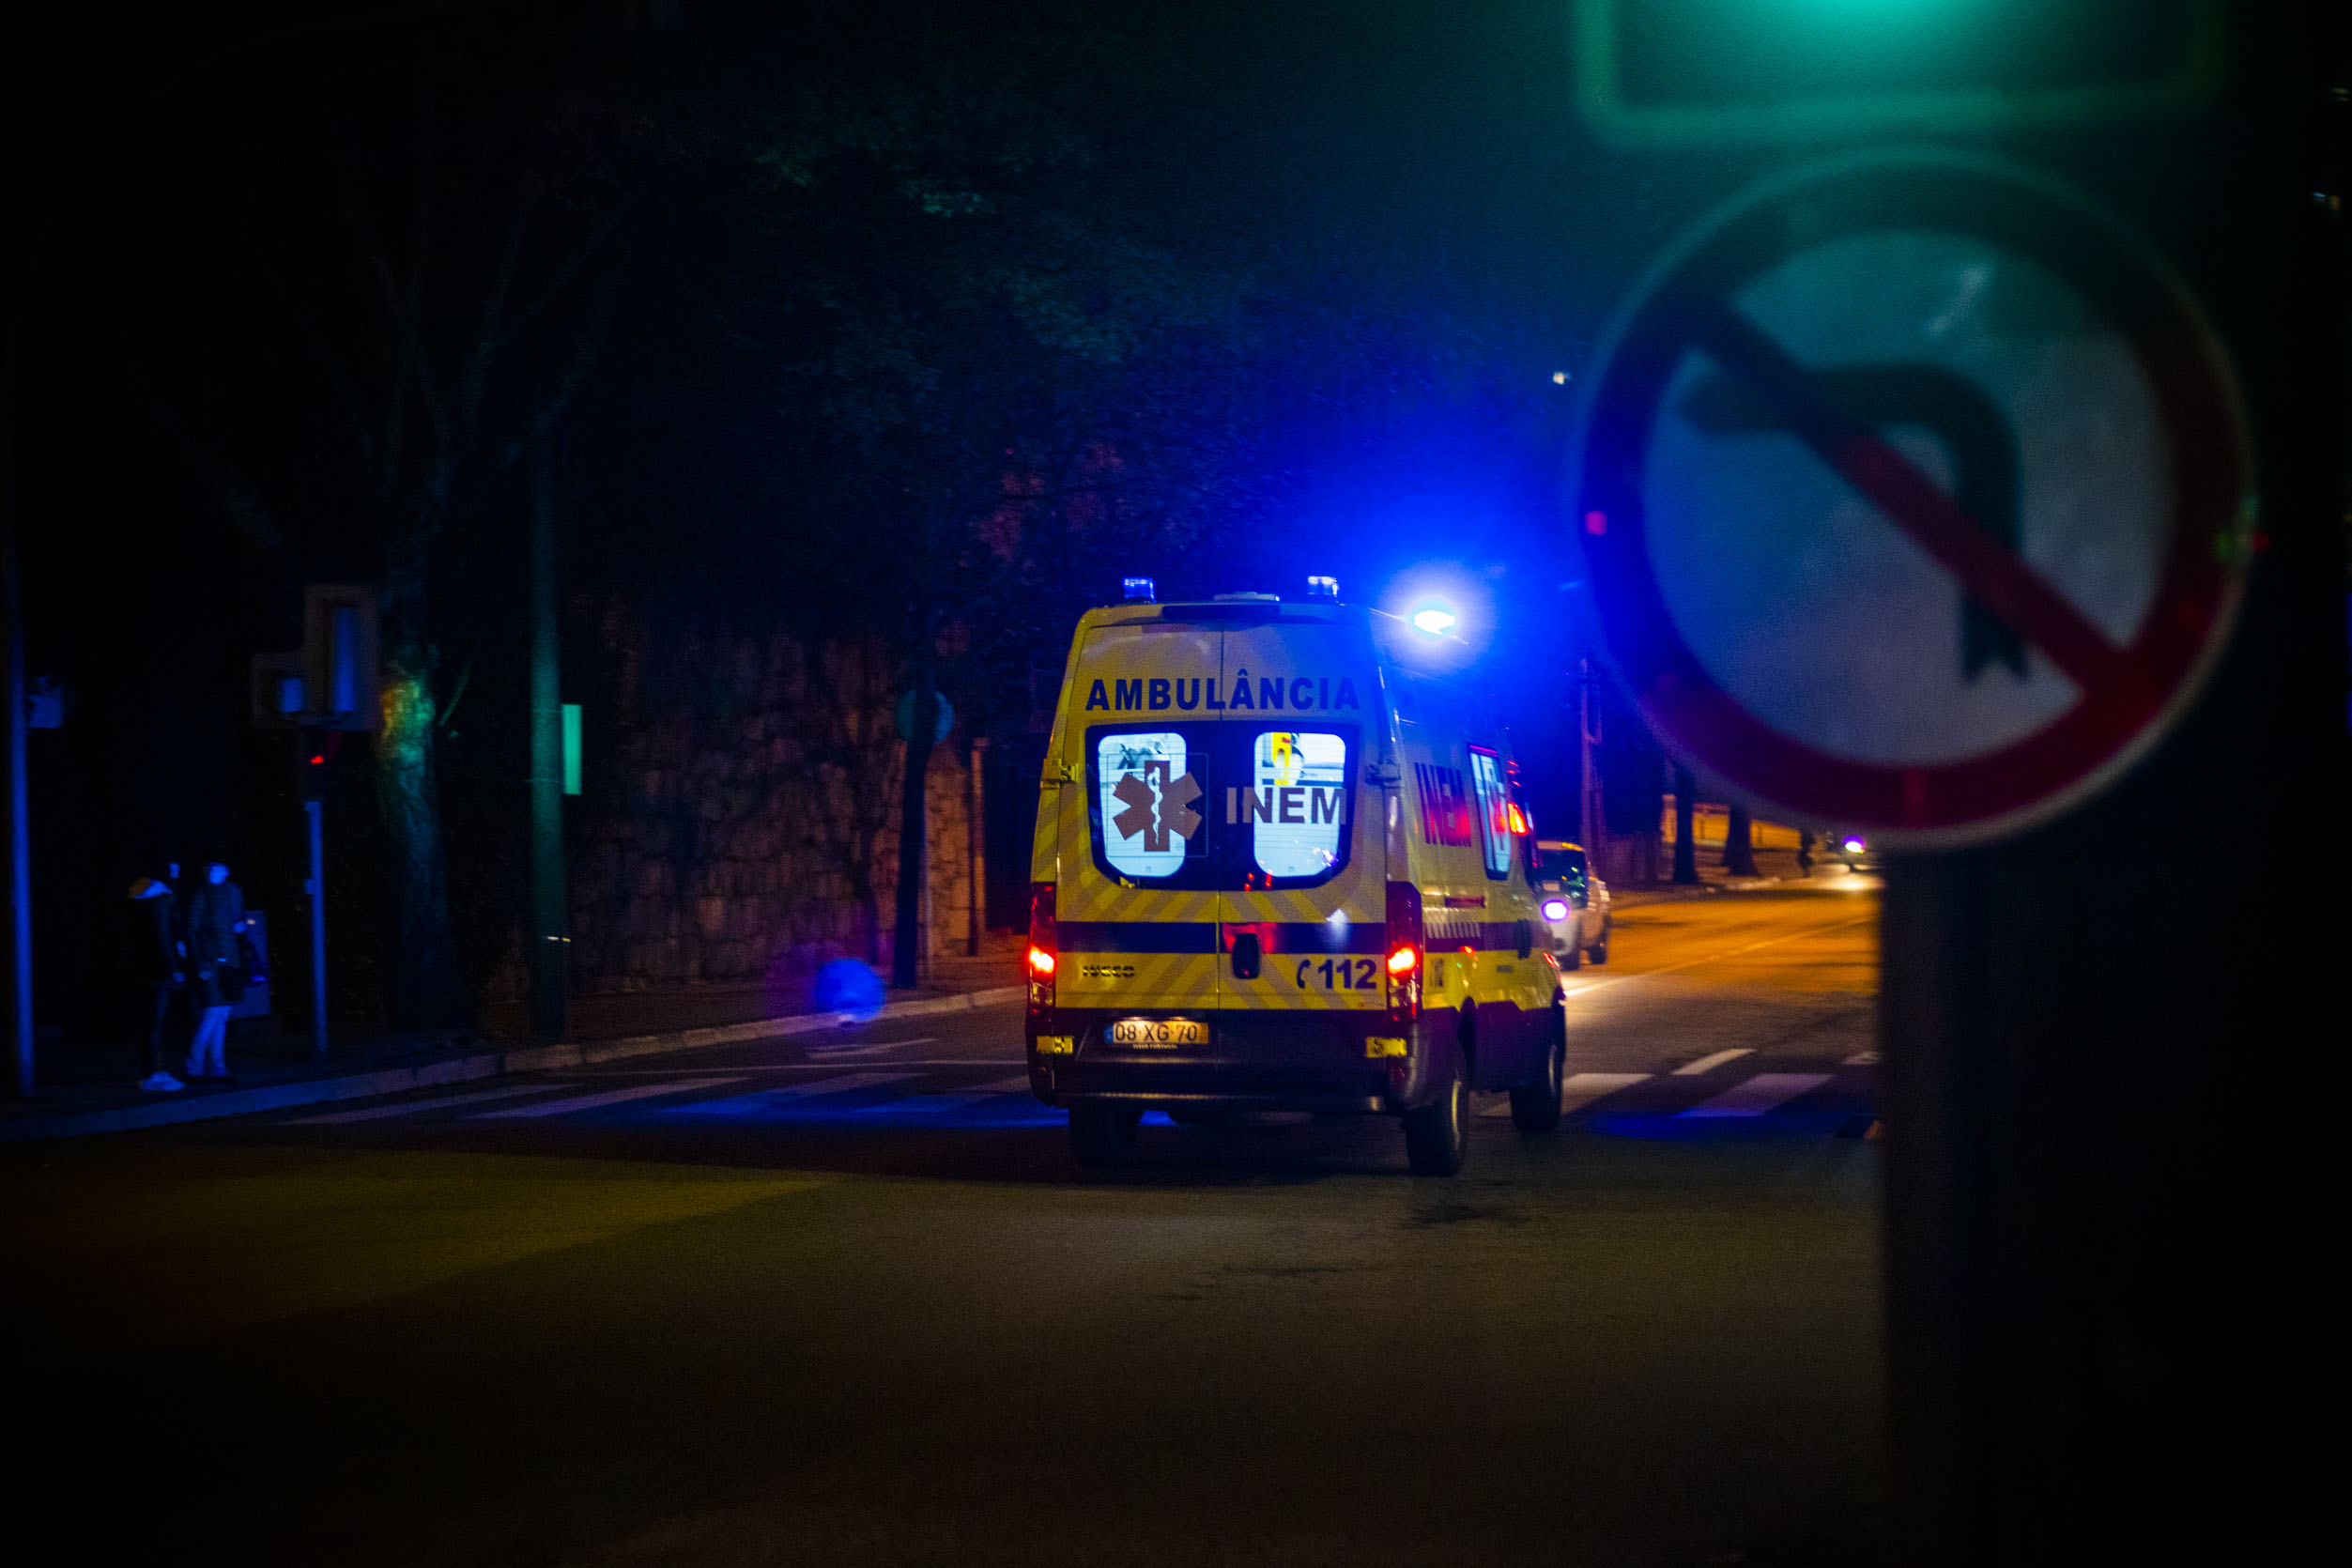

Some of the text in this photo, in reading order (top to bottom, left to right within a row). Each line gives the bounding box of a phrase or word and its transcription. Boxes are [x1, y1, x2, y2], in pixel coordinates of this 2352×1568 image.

[1085, 669, 1360, 711] AMBULÂNCIA
[1226, 786, 1347, 825] INEM
[1318, 959, 1377, 989] 112
